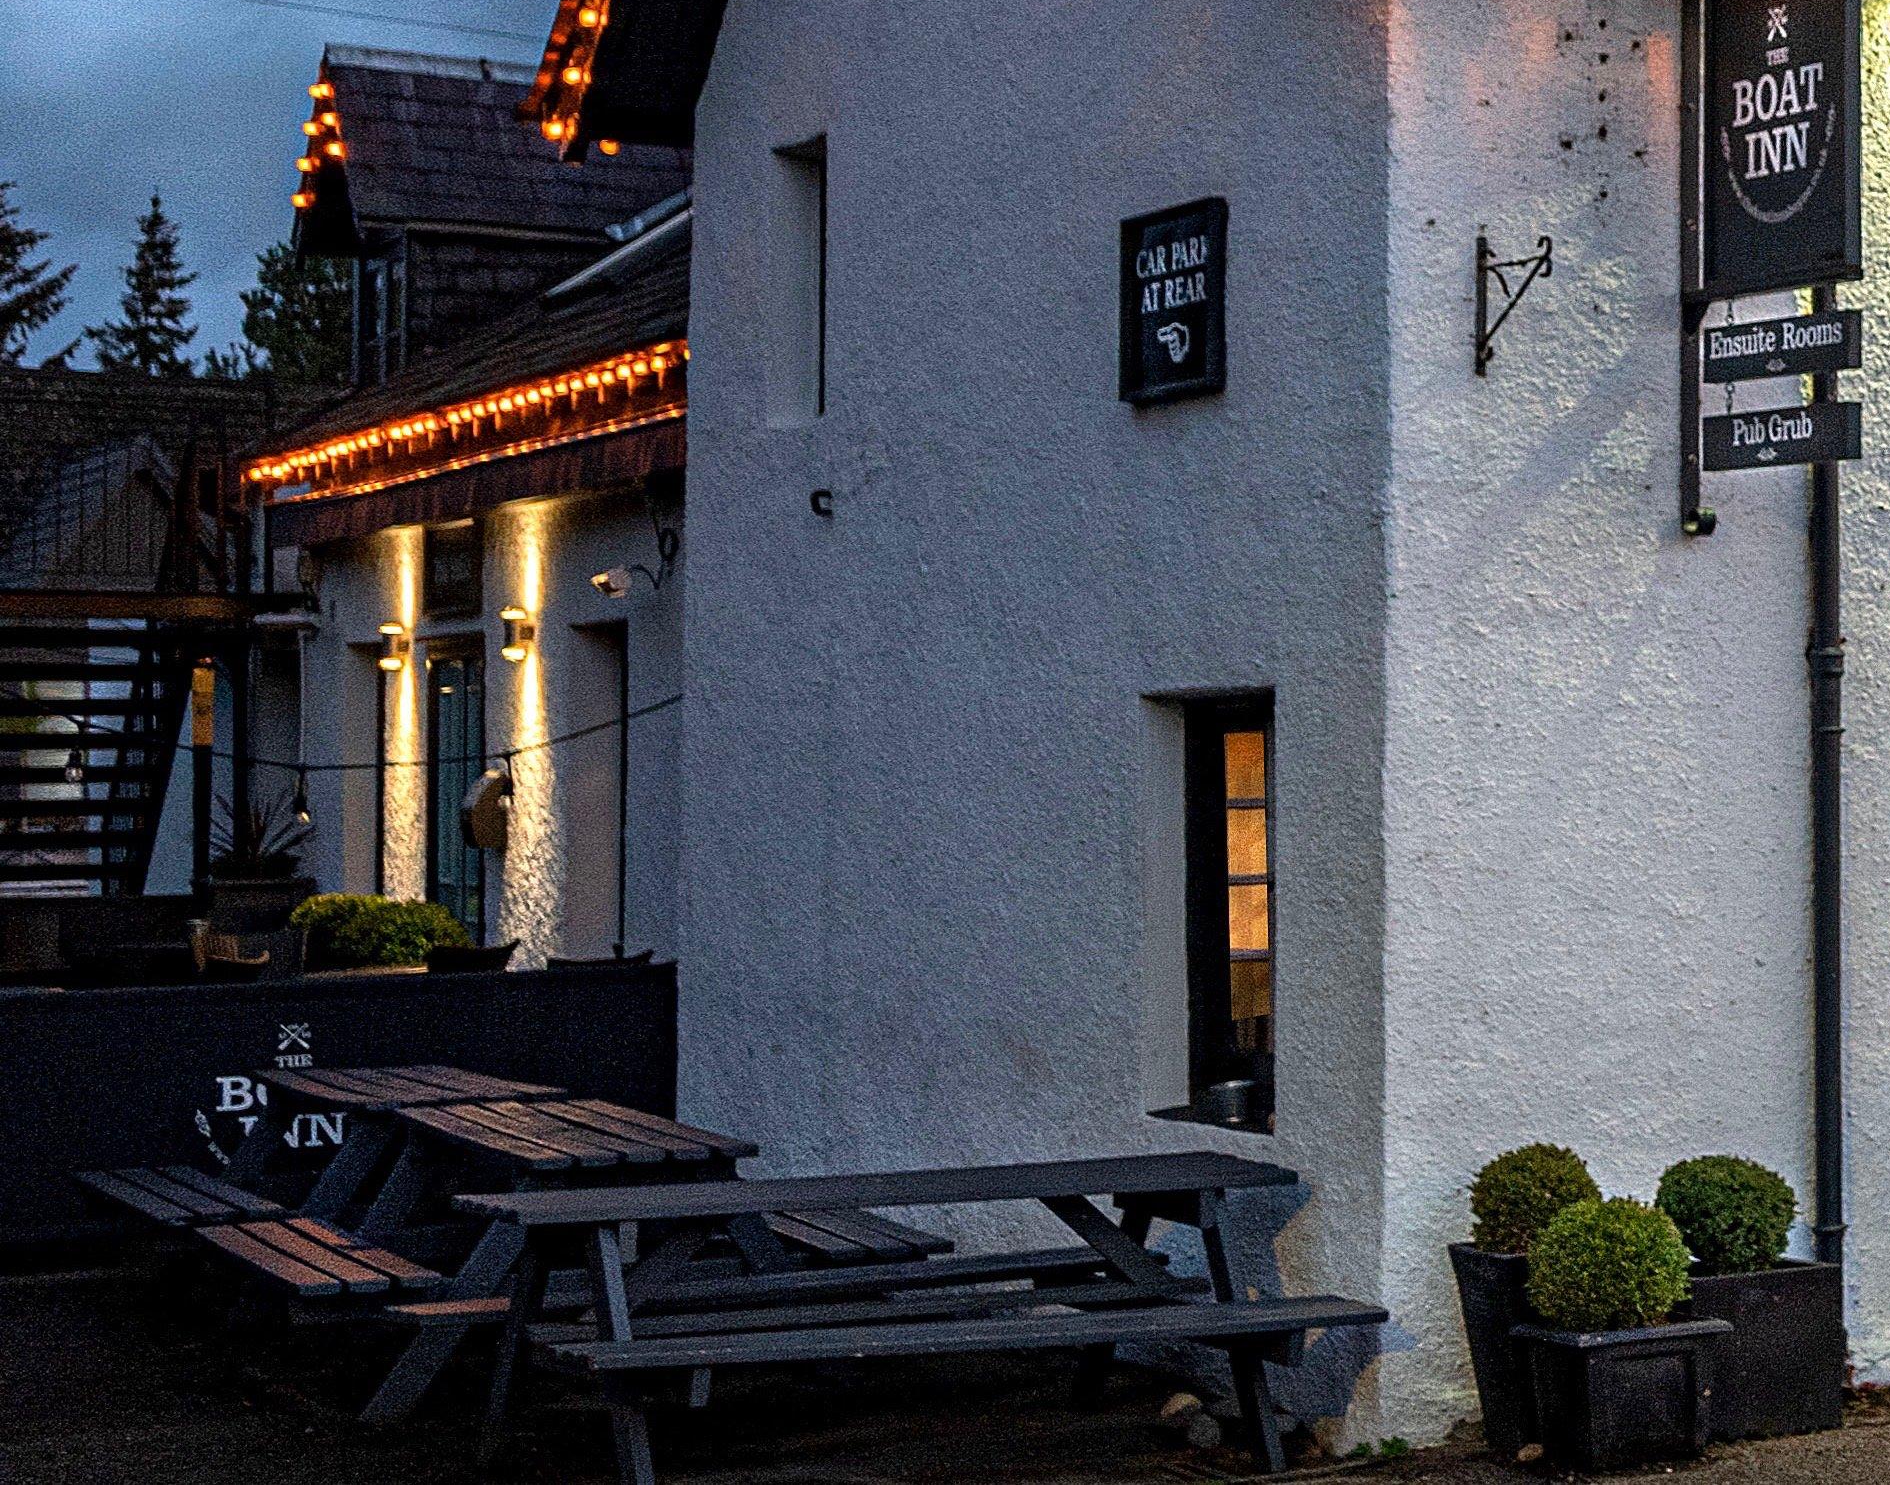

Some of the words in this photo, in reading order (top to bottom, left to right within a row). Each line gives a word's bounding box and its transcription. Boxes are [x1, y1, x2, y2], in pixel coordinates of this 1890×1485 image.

[1732, 63, 1823, 127] BOAT
[1744, 122, 1810, 180] INN
[1136, 245, 1167, 278] CAR
[1141, 282, 1161, 314] AT
[1165, 272, 1206, 309] REAR
[1709, 327, 1776, 360] Ensuite
[1781, 321, 1844, 350] Rooms
[1732, 416, 1765, 447] Pub
[1768, 411, 1813, 442] Grub
